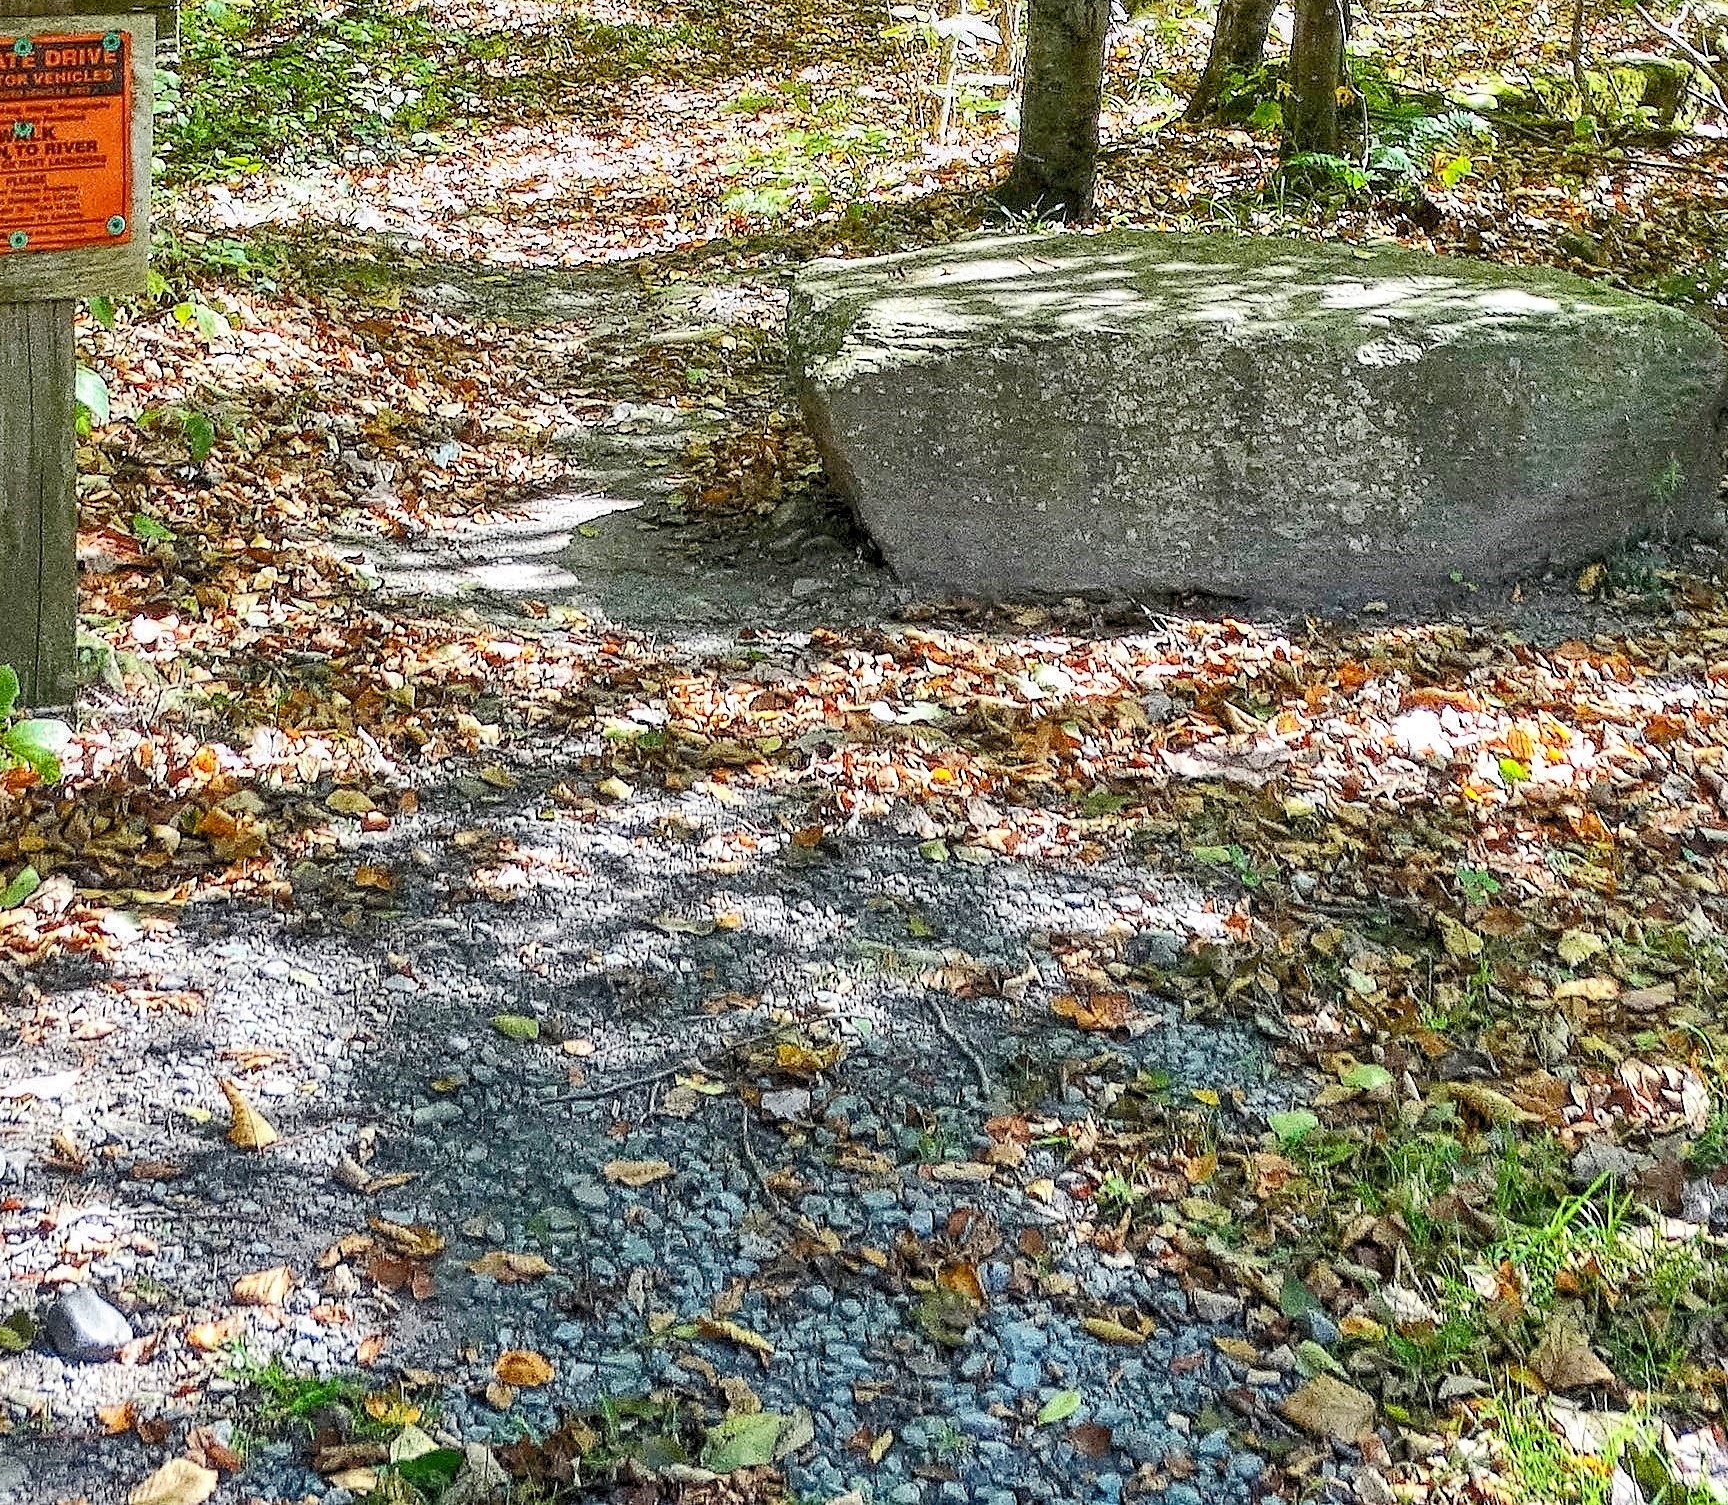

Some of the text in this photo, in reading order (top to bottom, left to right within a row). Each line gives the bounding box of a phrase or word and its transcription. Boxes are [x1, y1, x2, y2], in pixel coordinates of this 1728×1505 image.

[44, 47, 118, 67] DRIVE
[34, 69, 114, 85] VEHICLES
[15, 144, 39, 157] TO
[45, 140, 98, 155] RIVER
